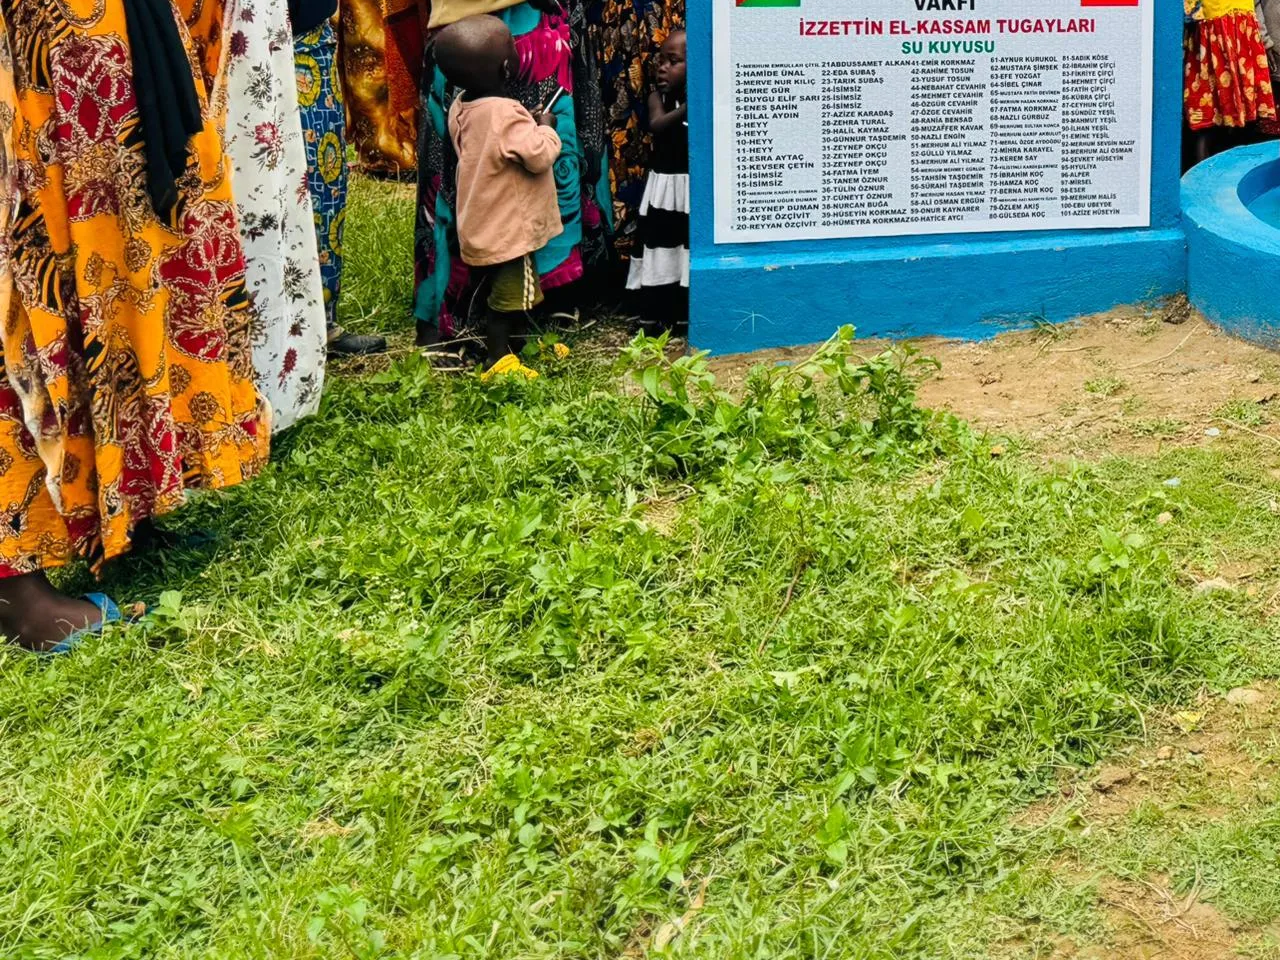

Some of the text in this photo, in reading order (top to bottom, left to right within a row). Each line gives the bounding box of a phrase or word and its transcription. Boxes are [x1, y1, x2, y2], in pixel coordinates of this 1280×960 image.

[799, 17, 1095, 36] İZZETTİN EL-KASSAM TUGAYLARI
[902, 40, 995, 55] SU KUYUSU
